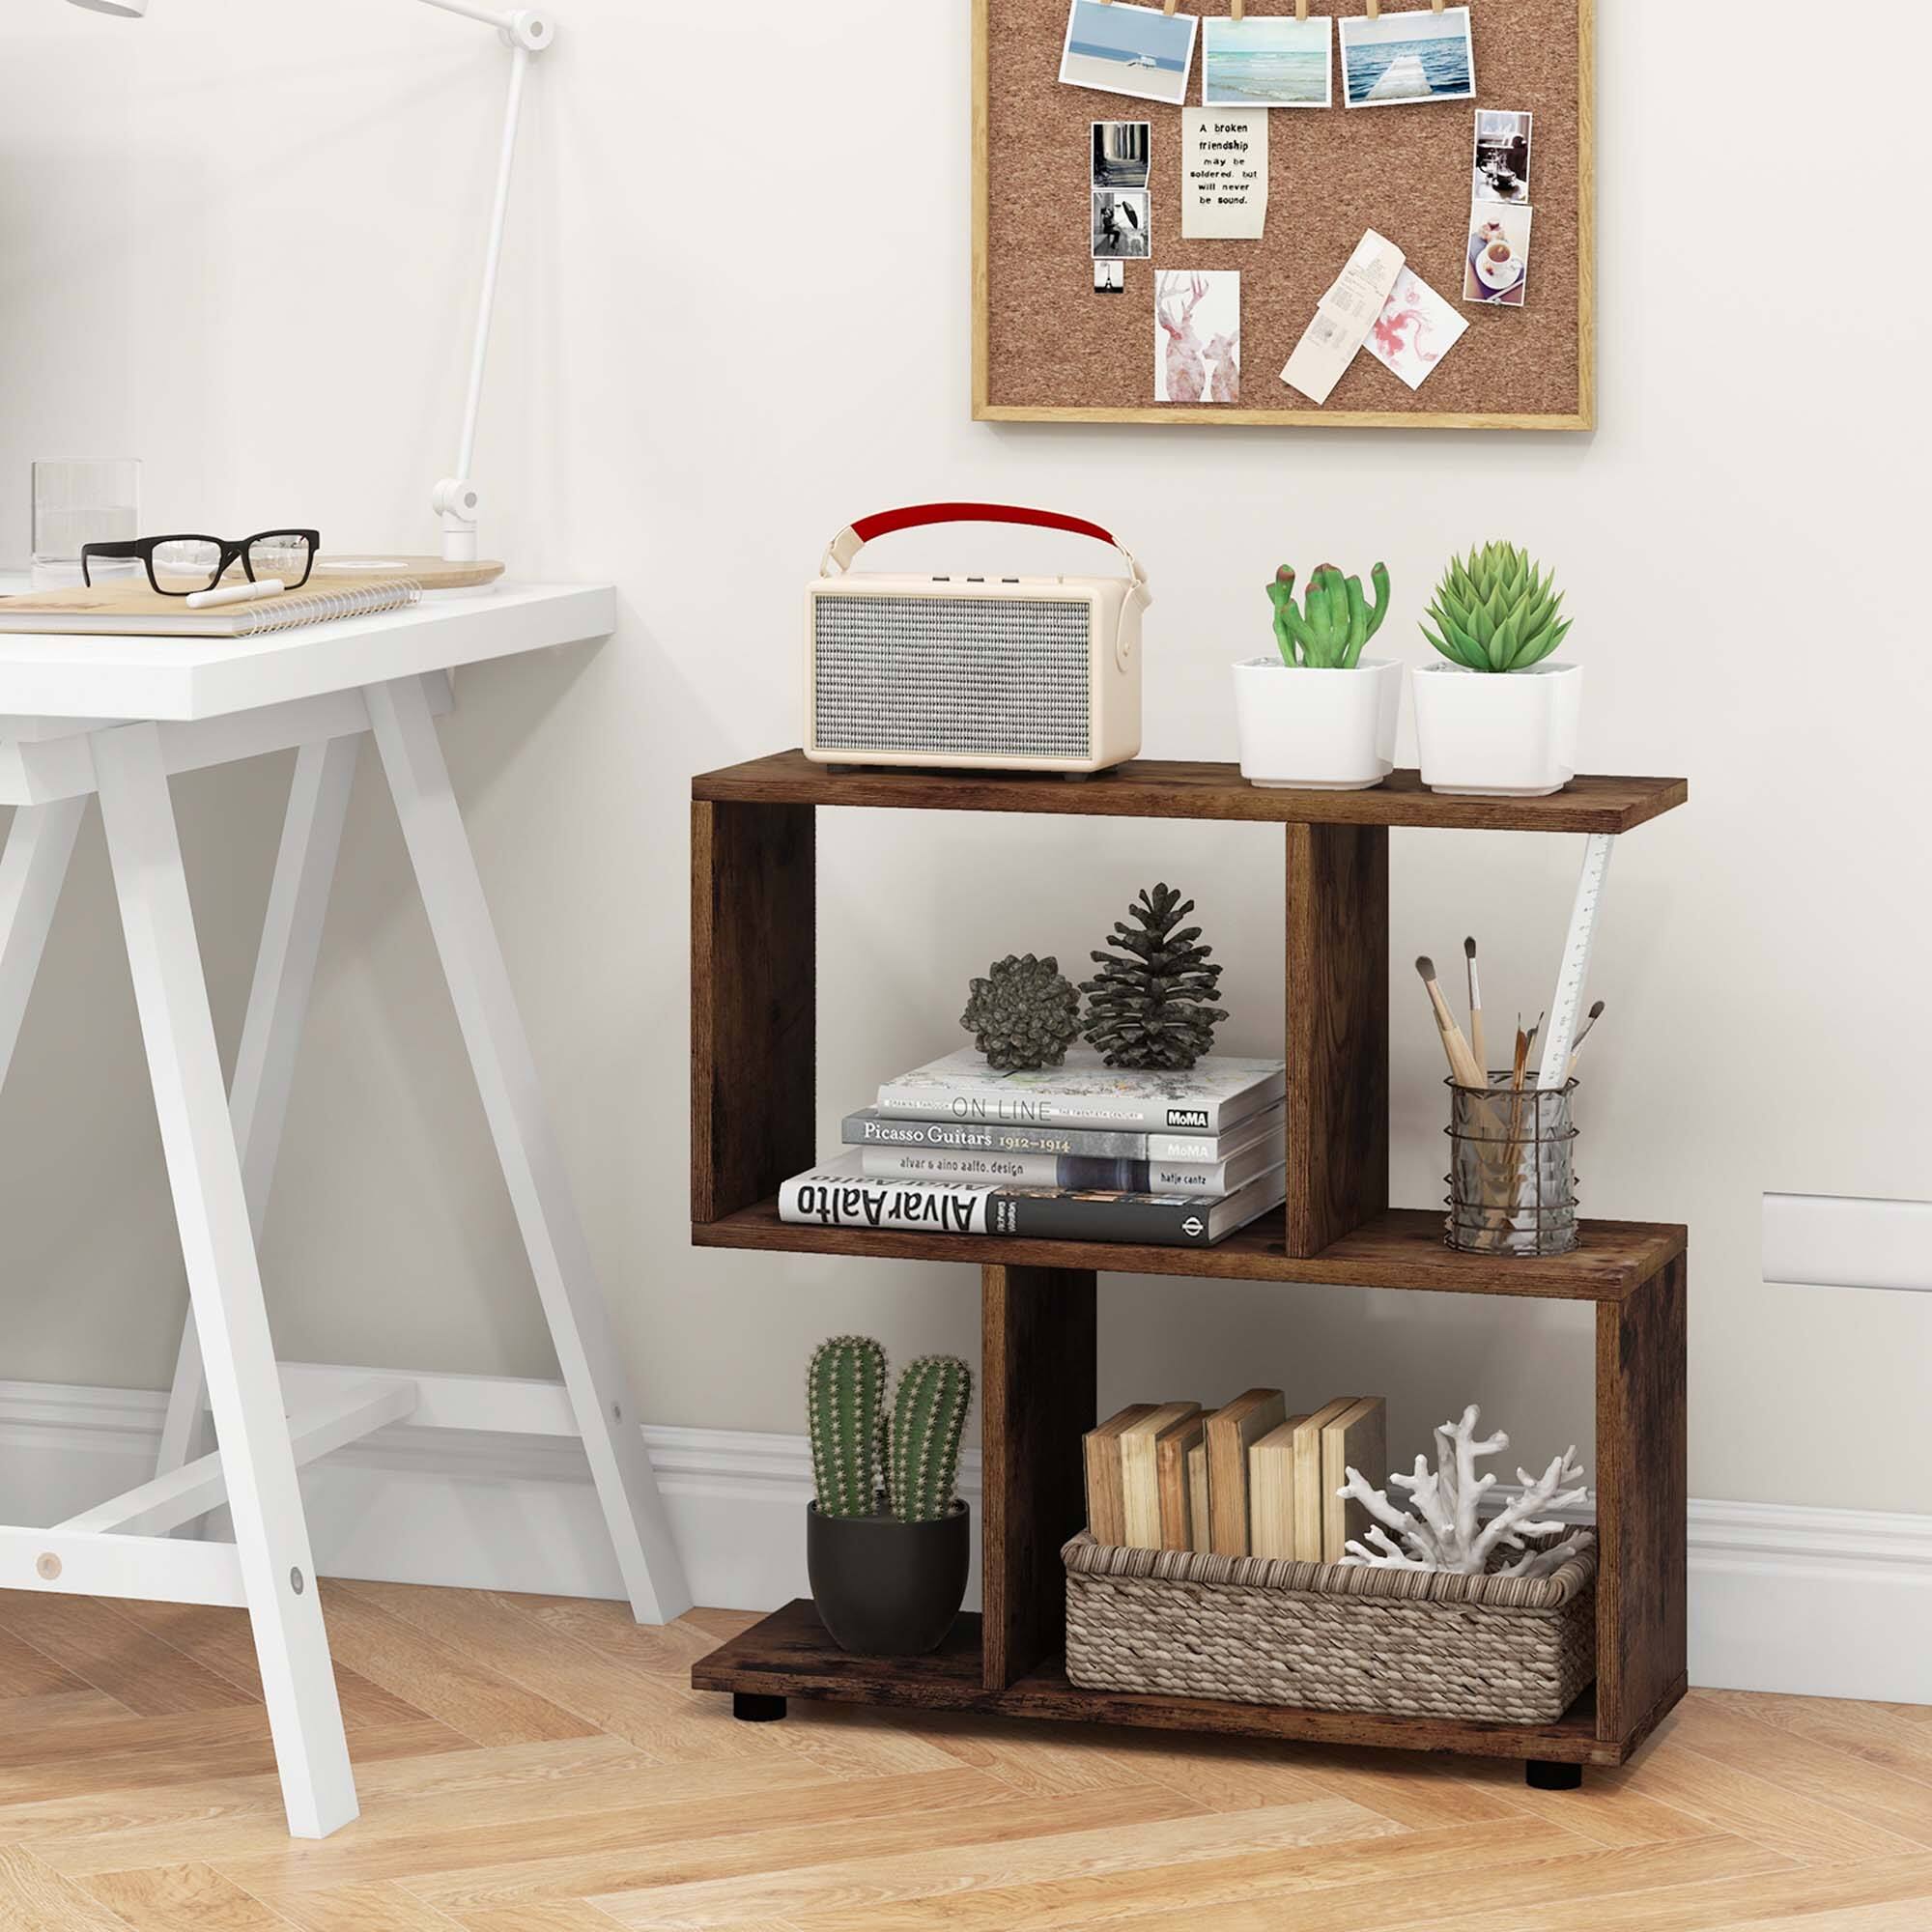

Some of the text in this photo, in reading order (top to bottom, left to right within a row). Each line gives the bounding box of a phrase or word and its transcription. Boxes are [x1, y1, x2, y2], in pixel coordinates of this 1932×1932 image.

[1199, 124, 1248, 132] A broken
[1199, 140, 1249, 152] friendship
[952, 1096, 985, 1118] ON
[999, 1099, 1052, 1121] LINE
[1168, 1111, 1207, 1126] MoMA
[864, 1122, 924, 1141] Picasso
[927, 1125, 992, 1146] Guitars
[1167, 1143, 1208, 1157] MoMA
[900, 1157, 925, 1169] alvar
[937, 1159, 958, 1171] aino
[990, 1162, 1024, 1177] design
[1160, 1172, 1207, 1185] hatje cantz
